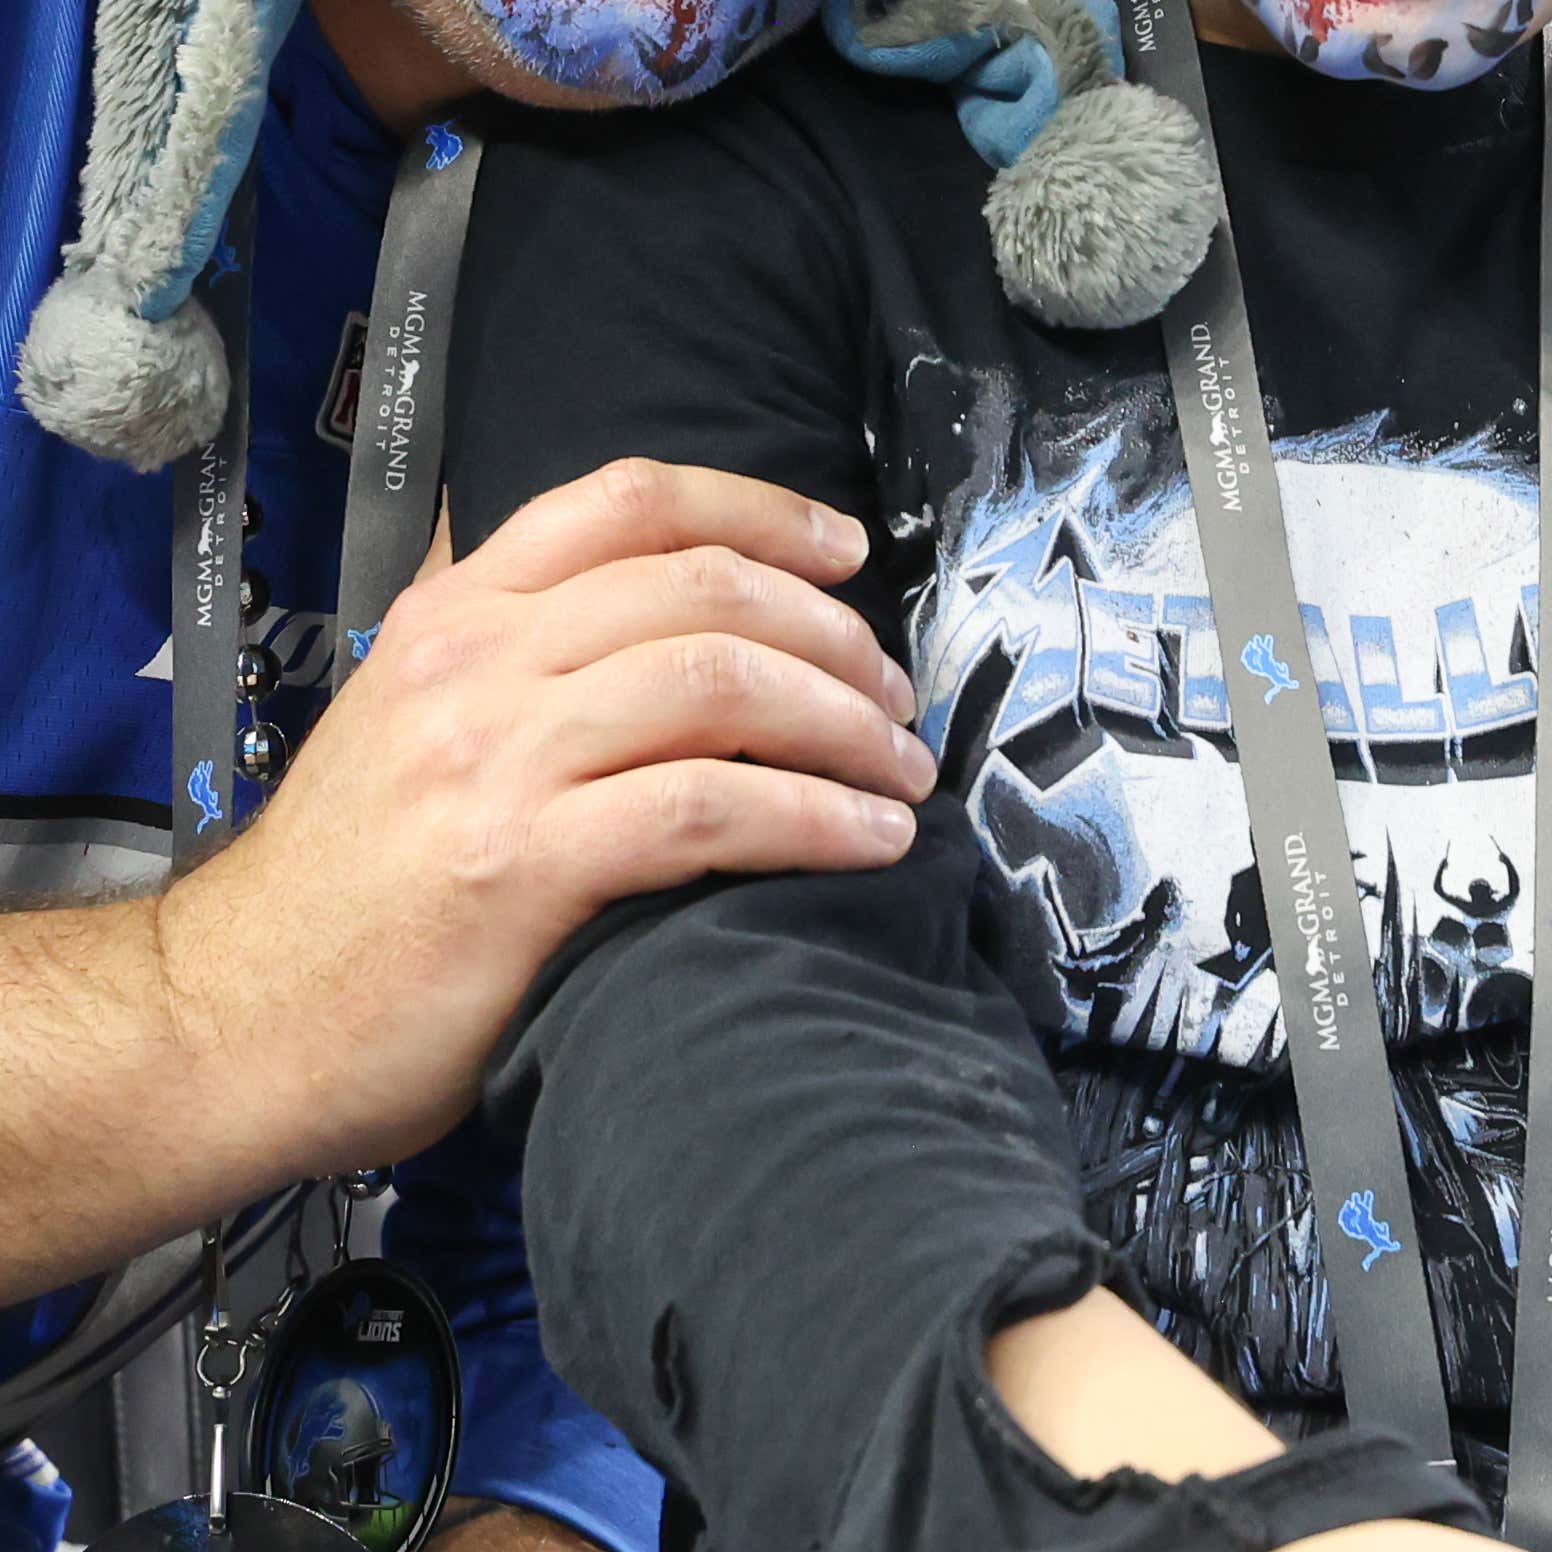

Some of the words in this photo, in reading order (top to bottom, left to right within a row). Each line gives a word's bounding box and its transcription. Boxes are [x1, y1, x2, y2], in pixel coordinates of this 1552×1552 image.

[1132, 0, 1157, 52] MGM
[401, 290, 428, 355] MGM
[376, 326, 401, 450] DETROIT
[1190, 323, 1223, 411] GRAND
[385, 396, 416, 491] GRAND
[1218, 357, 1250, 474] DETROIT
[198, 442, 216, 521] GRAN
[214, 459, 228, 587] DETROIT
[1214, 448, 1243, 512] MGM
[196, 559, 213, 627] MGM
[1284, 833, 1321, 936] GRAND
[1315, 871, 1350, 1007] DETROIT
[1309, 977, 1341, 1051] MGM
